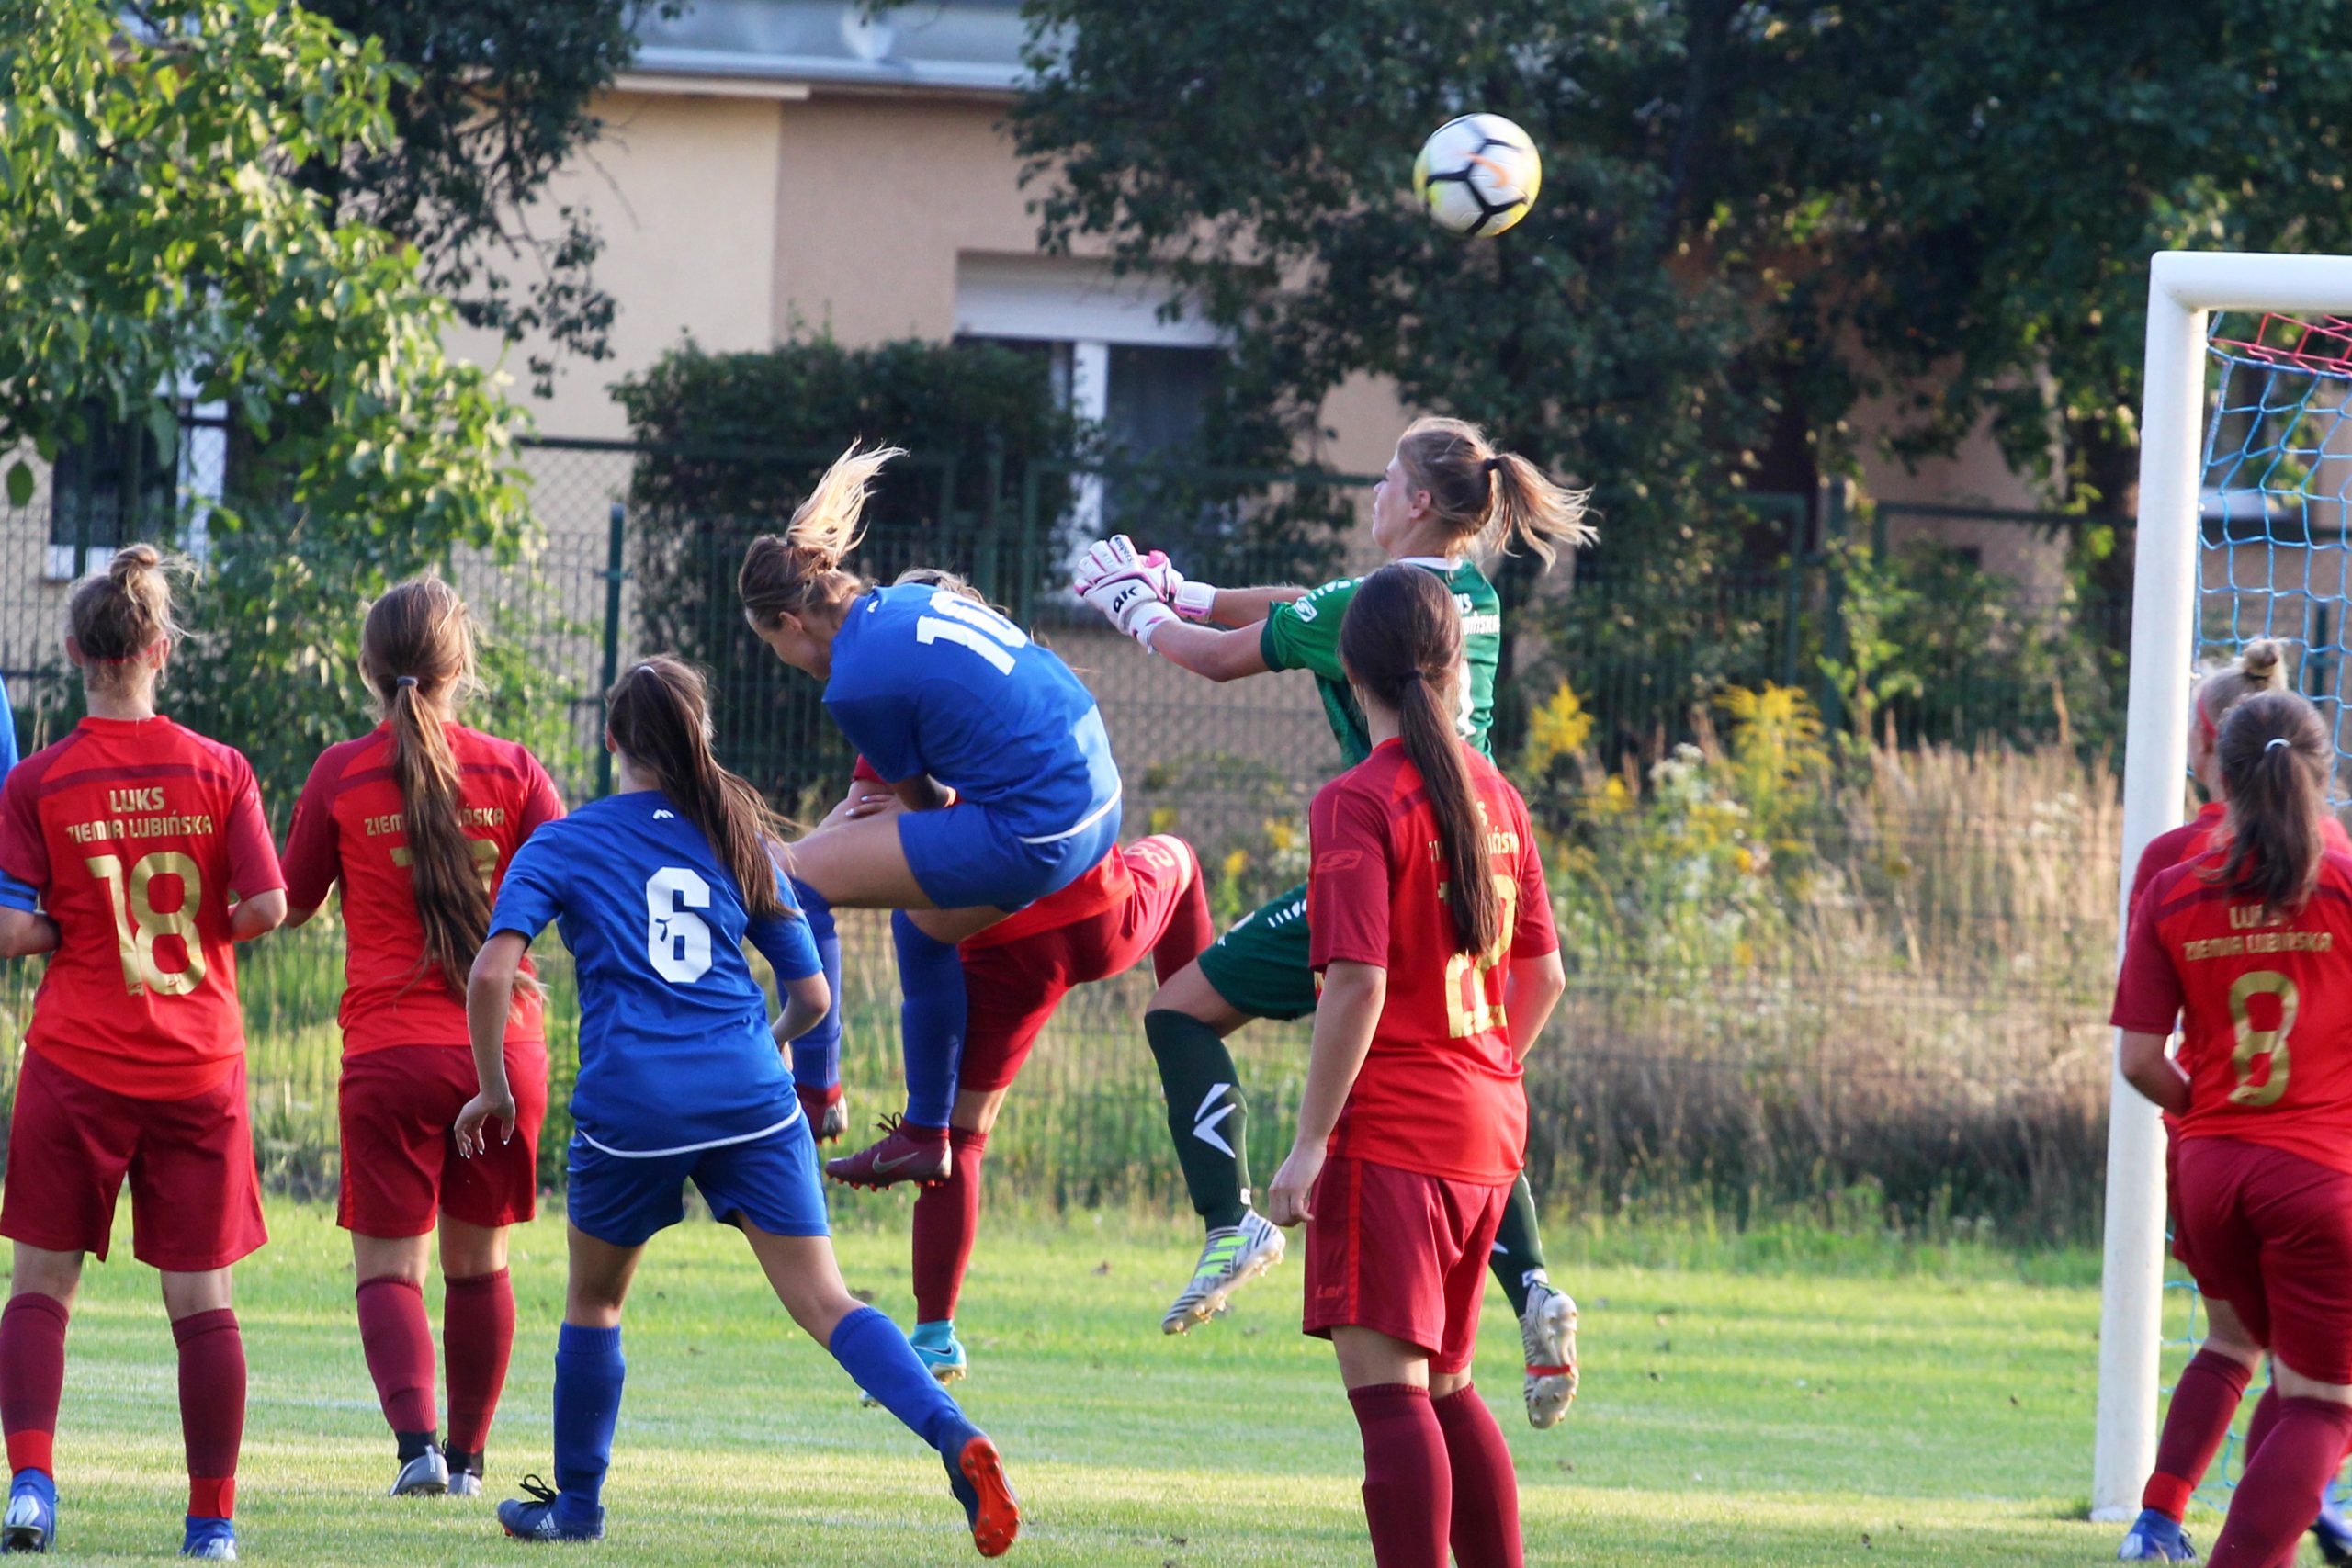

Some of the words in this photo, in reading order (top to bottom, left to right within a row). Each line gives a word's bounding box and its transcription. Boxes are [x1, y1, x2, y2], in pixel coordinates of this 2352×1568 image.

[916, 590, 1029, 676] 10
[109, 787, 165, 813] LUKS
[129, 810, 213, 838] LUBIŃSKA
[364, 814, 405, 836] ZIEM
[85, 851, 207, 996] 18
[646, 867, 712, 983] 6
[2228, 970, 2300, 1106] 8
